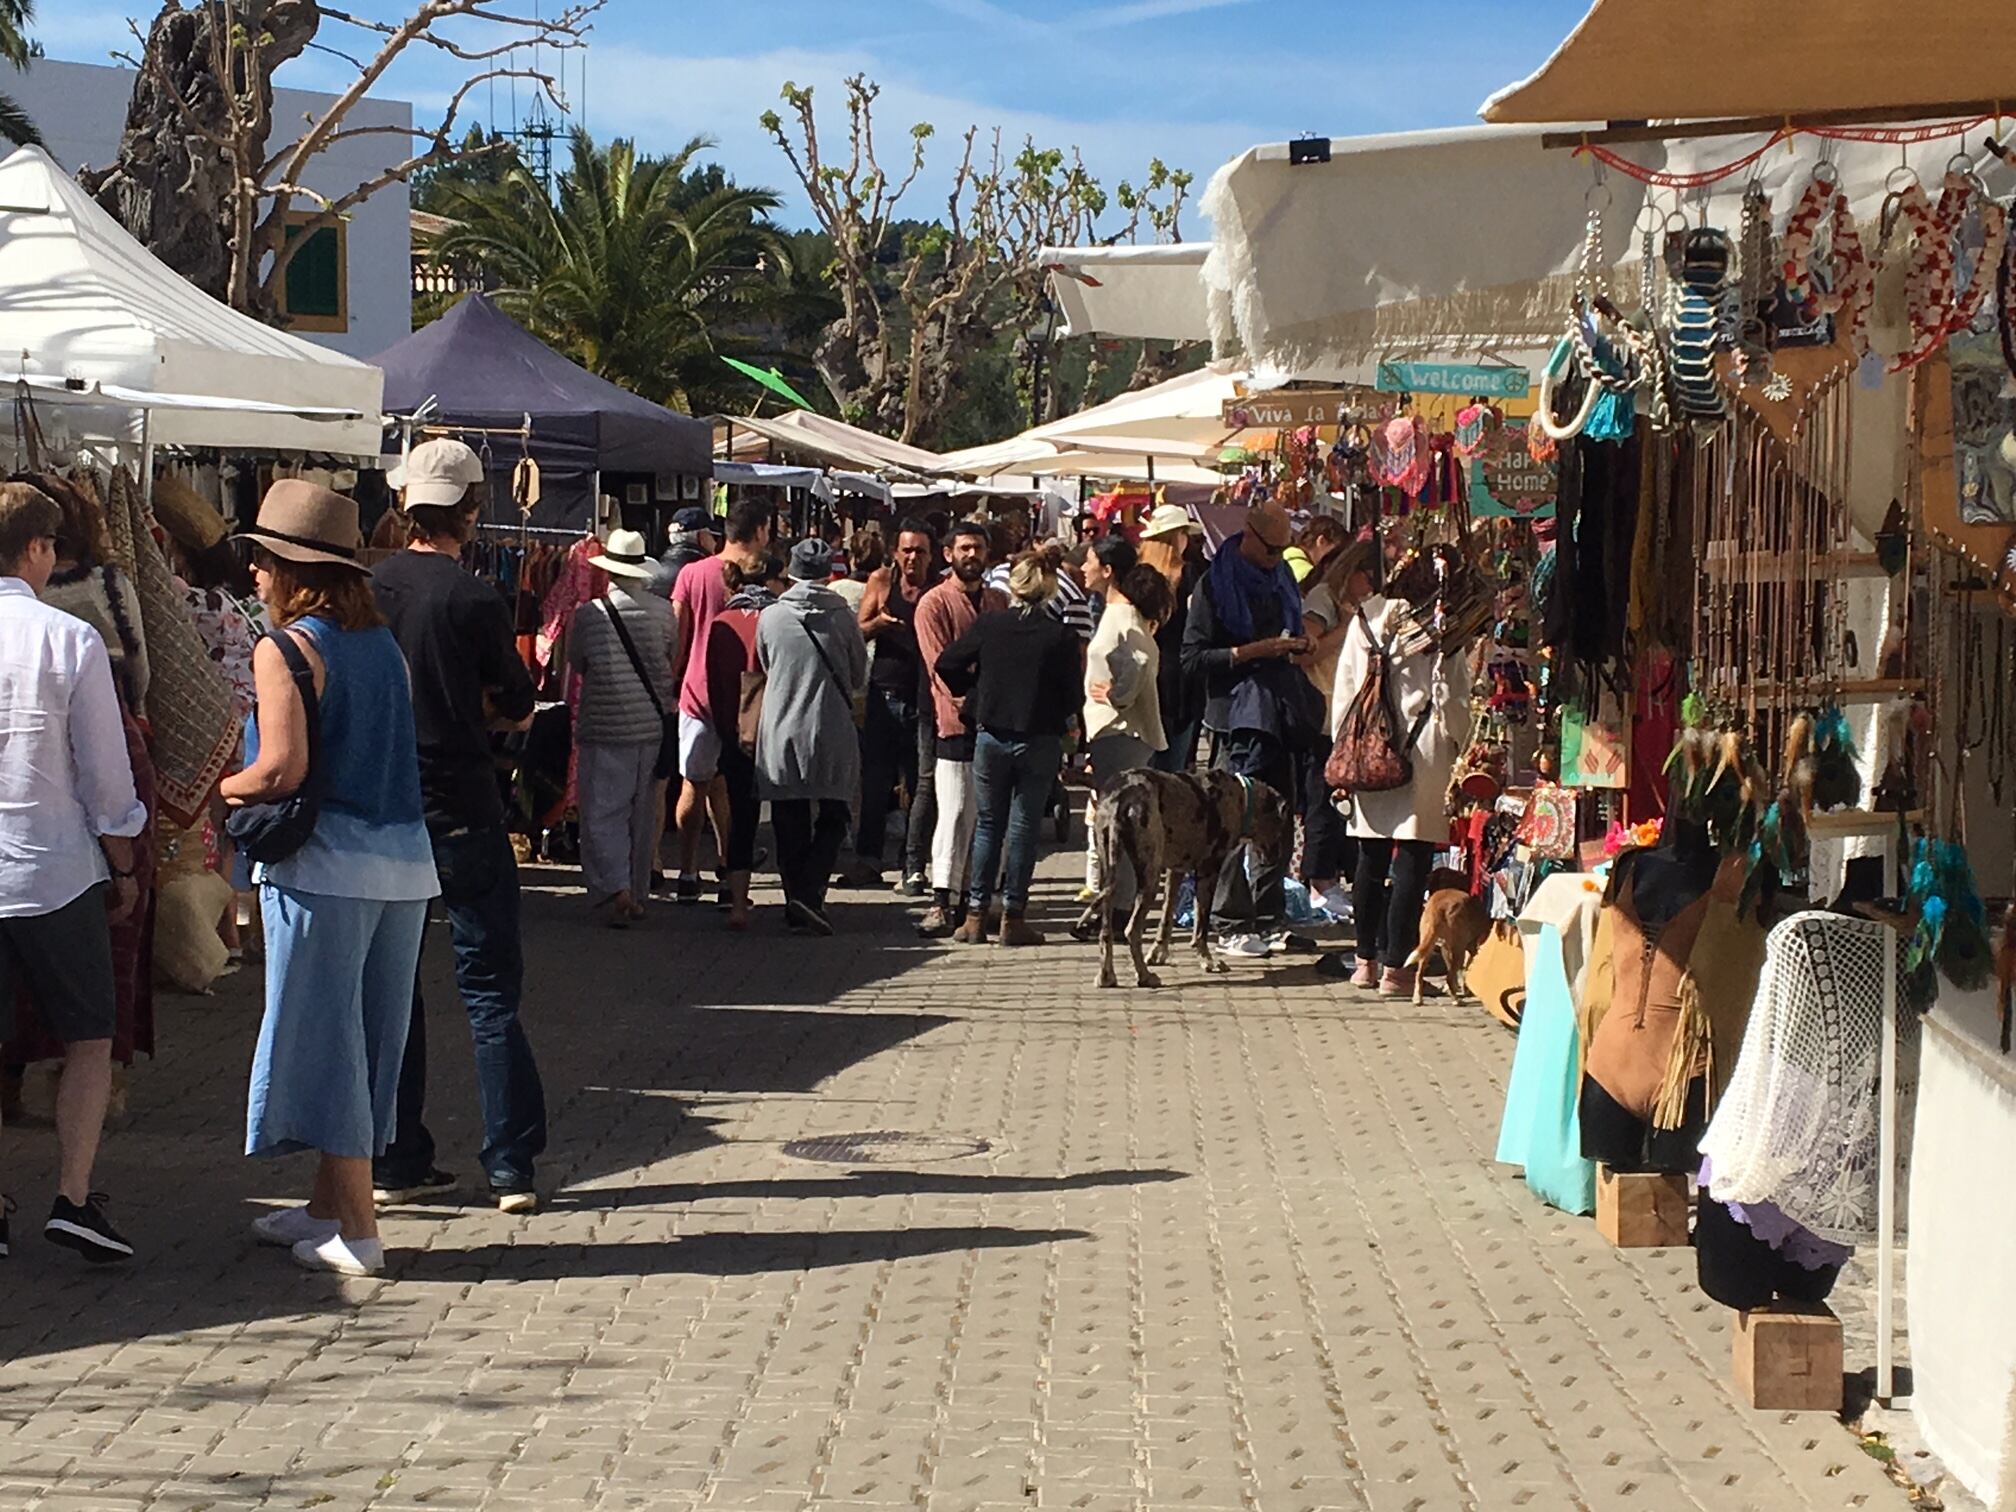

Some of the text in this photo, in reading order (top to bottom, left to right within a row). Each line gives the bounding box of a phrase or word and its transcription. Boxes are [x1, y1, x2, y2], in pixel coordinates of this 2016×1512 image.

[1250, 406, 1293, 424] Viva
[1304, 405, 1325, 423] la
[1497, 473, 1549, 491] Home
